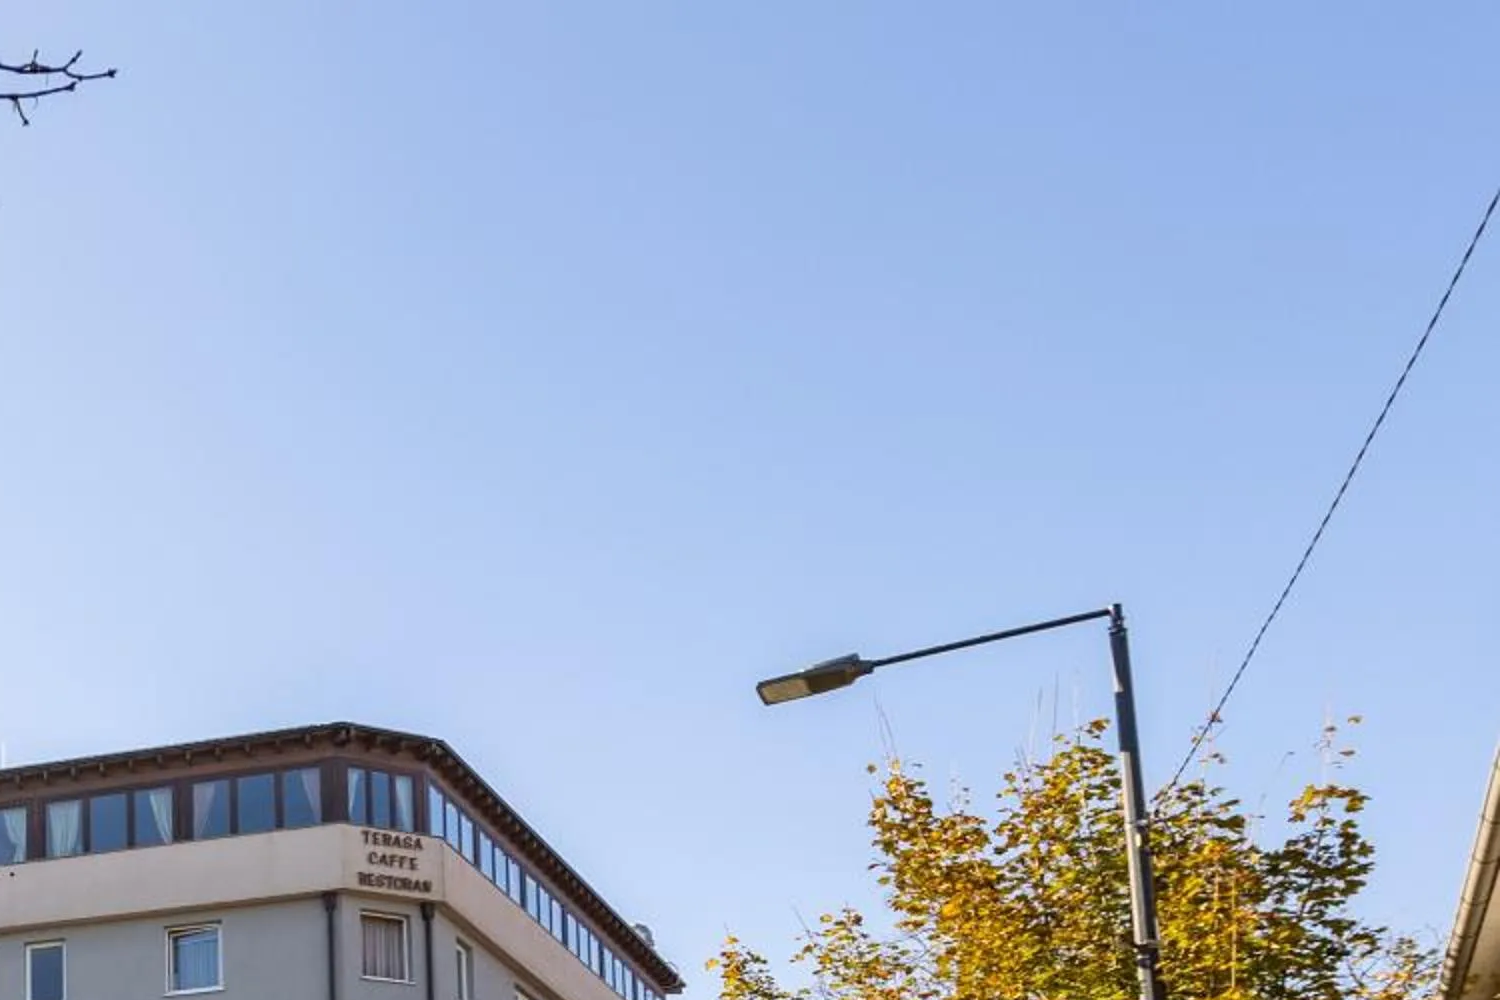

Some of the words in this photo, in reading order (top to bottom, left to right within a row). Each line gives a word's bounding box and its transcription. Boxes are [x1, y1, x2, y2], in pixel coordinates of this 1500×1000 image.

[361, 829, 423, 851] TERASA
[368, 851, 419, 871] CAFFE
[357, 871, 432, 893] RESTORAN
